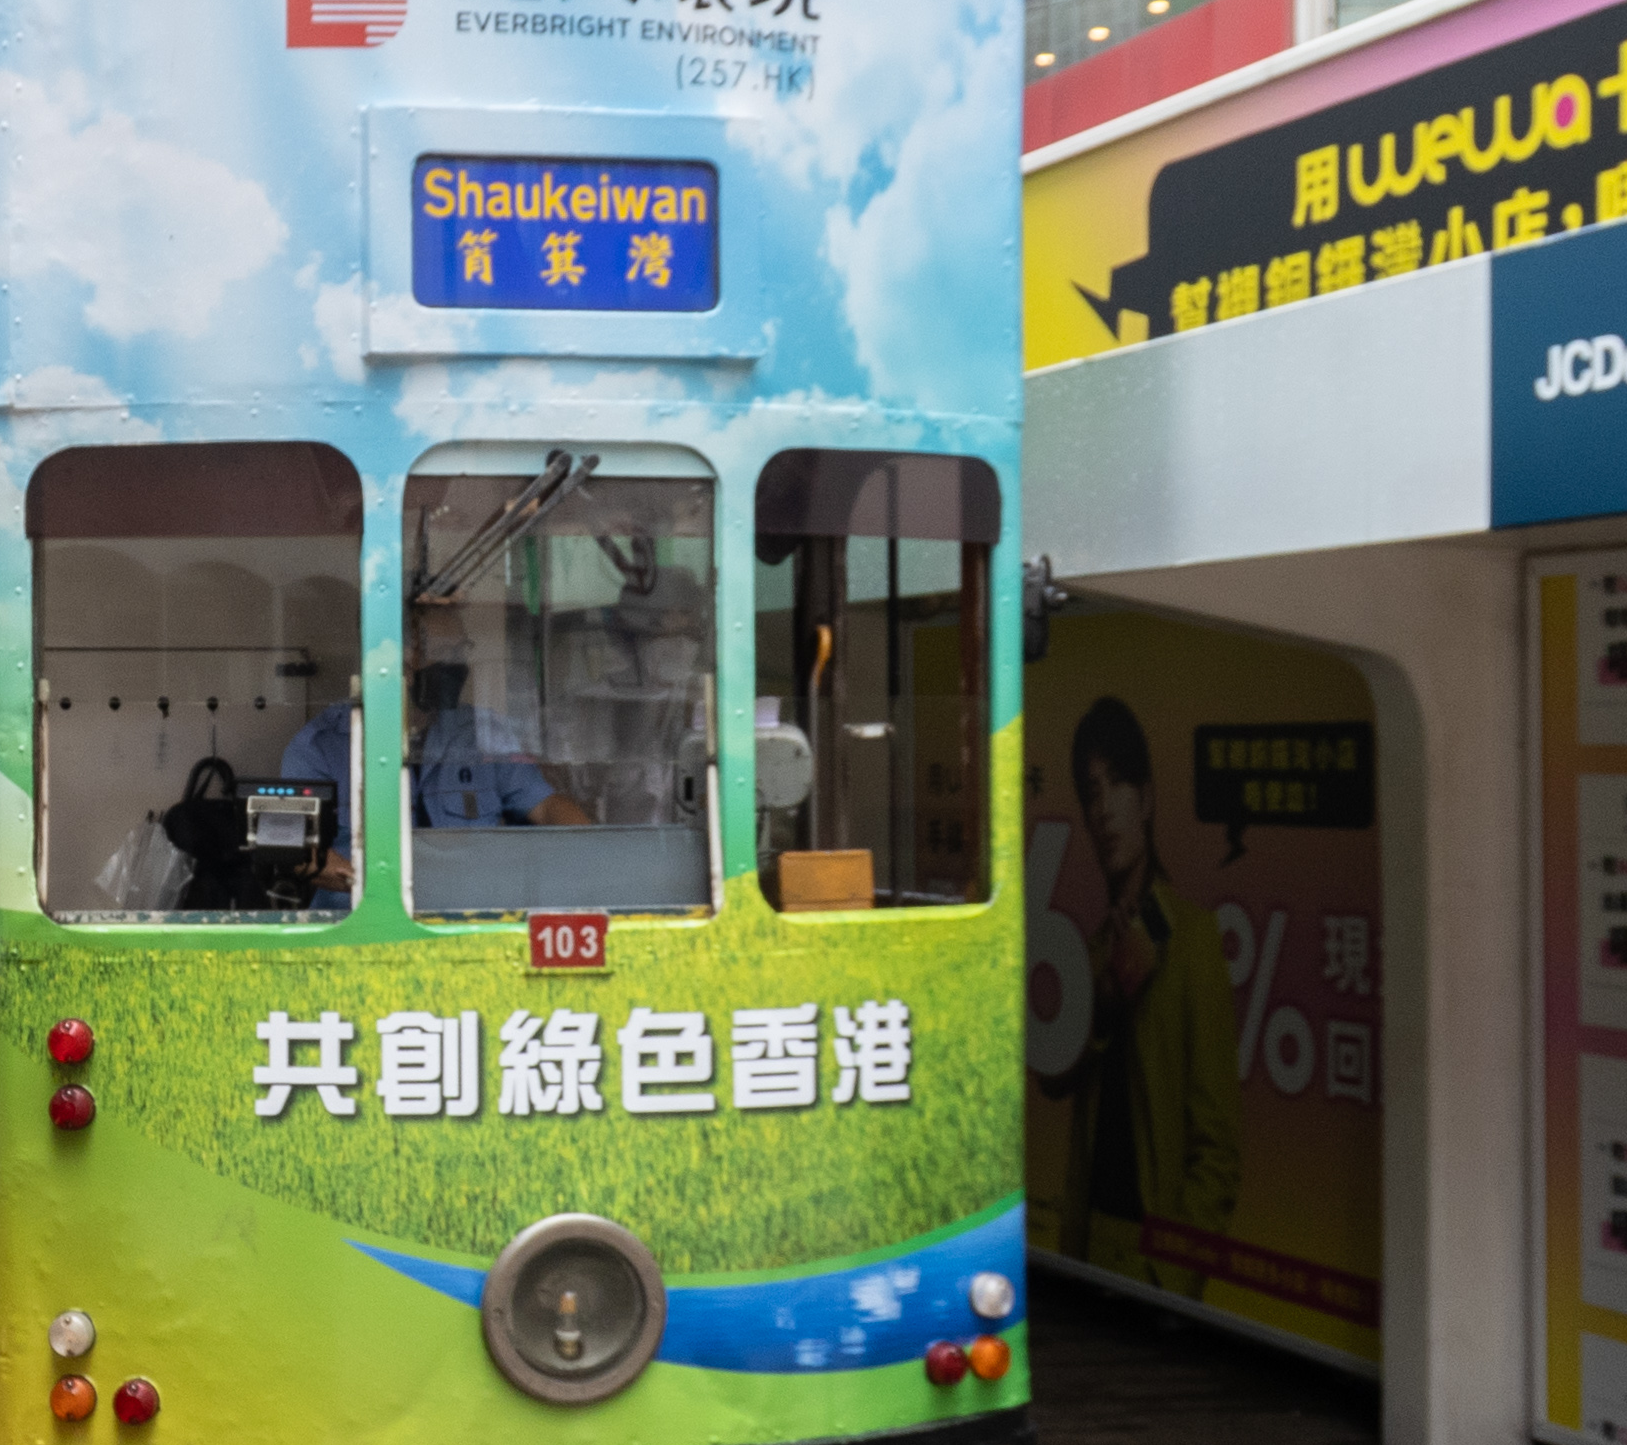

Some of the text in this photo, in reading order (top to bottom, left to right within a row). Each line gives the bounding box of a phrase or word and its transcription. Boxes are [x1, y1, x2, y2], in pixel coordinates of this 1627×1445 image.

[455, 10, 821, 56] EVERBRIGHT ENVIRONMENT
[675, 55, 817, 101] (257.HK)
[422, 168, 708, 224] Shaukeiwan
[455, 228, 674, 288] 筲箕灣
[536, 923, 600, 960] 103
[252, 997, 915, 1122] 共創綠色香港
